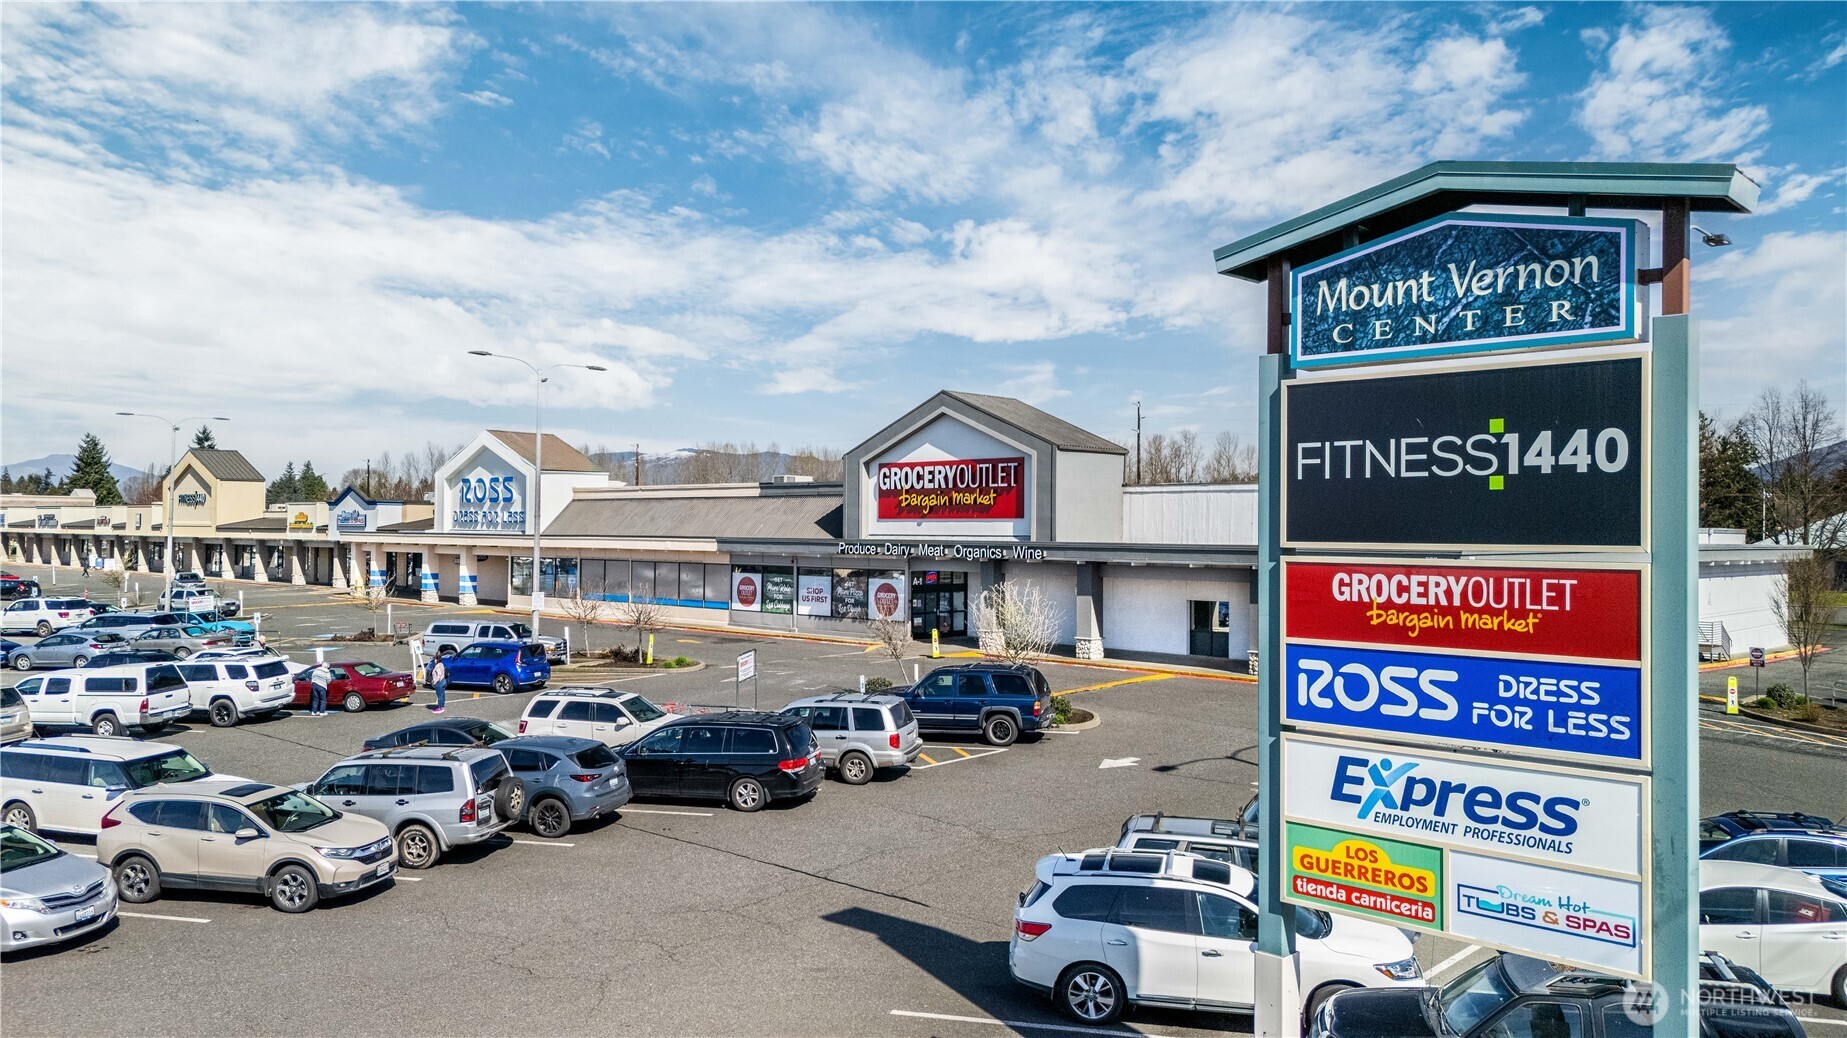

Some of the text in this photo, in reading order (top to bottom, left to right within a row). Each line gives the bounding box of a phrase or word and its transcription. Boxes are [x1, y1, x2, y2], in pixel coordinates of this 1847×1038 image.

[1316, 254, 1599, 316] Mount Vernon
[1332, 300, 1576, 344] CENTER
[461, 476, 514, 503] ROSS
[899, 485, 997, 514] bargain market
[454, 510, 526, 523] DRESS FOR LESS
[838, 542, 1043, 561] Produce Dairy Meat Organics Wine
[806, 587, 824, 595] SHOP
[1366, 597, 1540, 637] bargain market
[1297, 658, 1459, 722] ROSS
[1498, 674, 1600, 706] DRESS
[1472, 701, 1631, 741] FOR LESS
[1373, 811, 1574, 855] EMPLOYMENT PROFESSIONALS
[1345, 845, 1379, 864] LOS
[1299, 853, 1428, 894] GUERREROS
[1295, 877, 1433, 920] tienda carniceria
[1496, 884, 1591, 915] Dream Hot
[1542, 910, 1560, 926] &
[1565, 914, 1631, 940] SPAS
